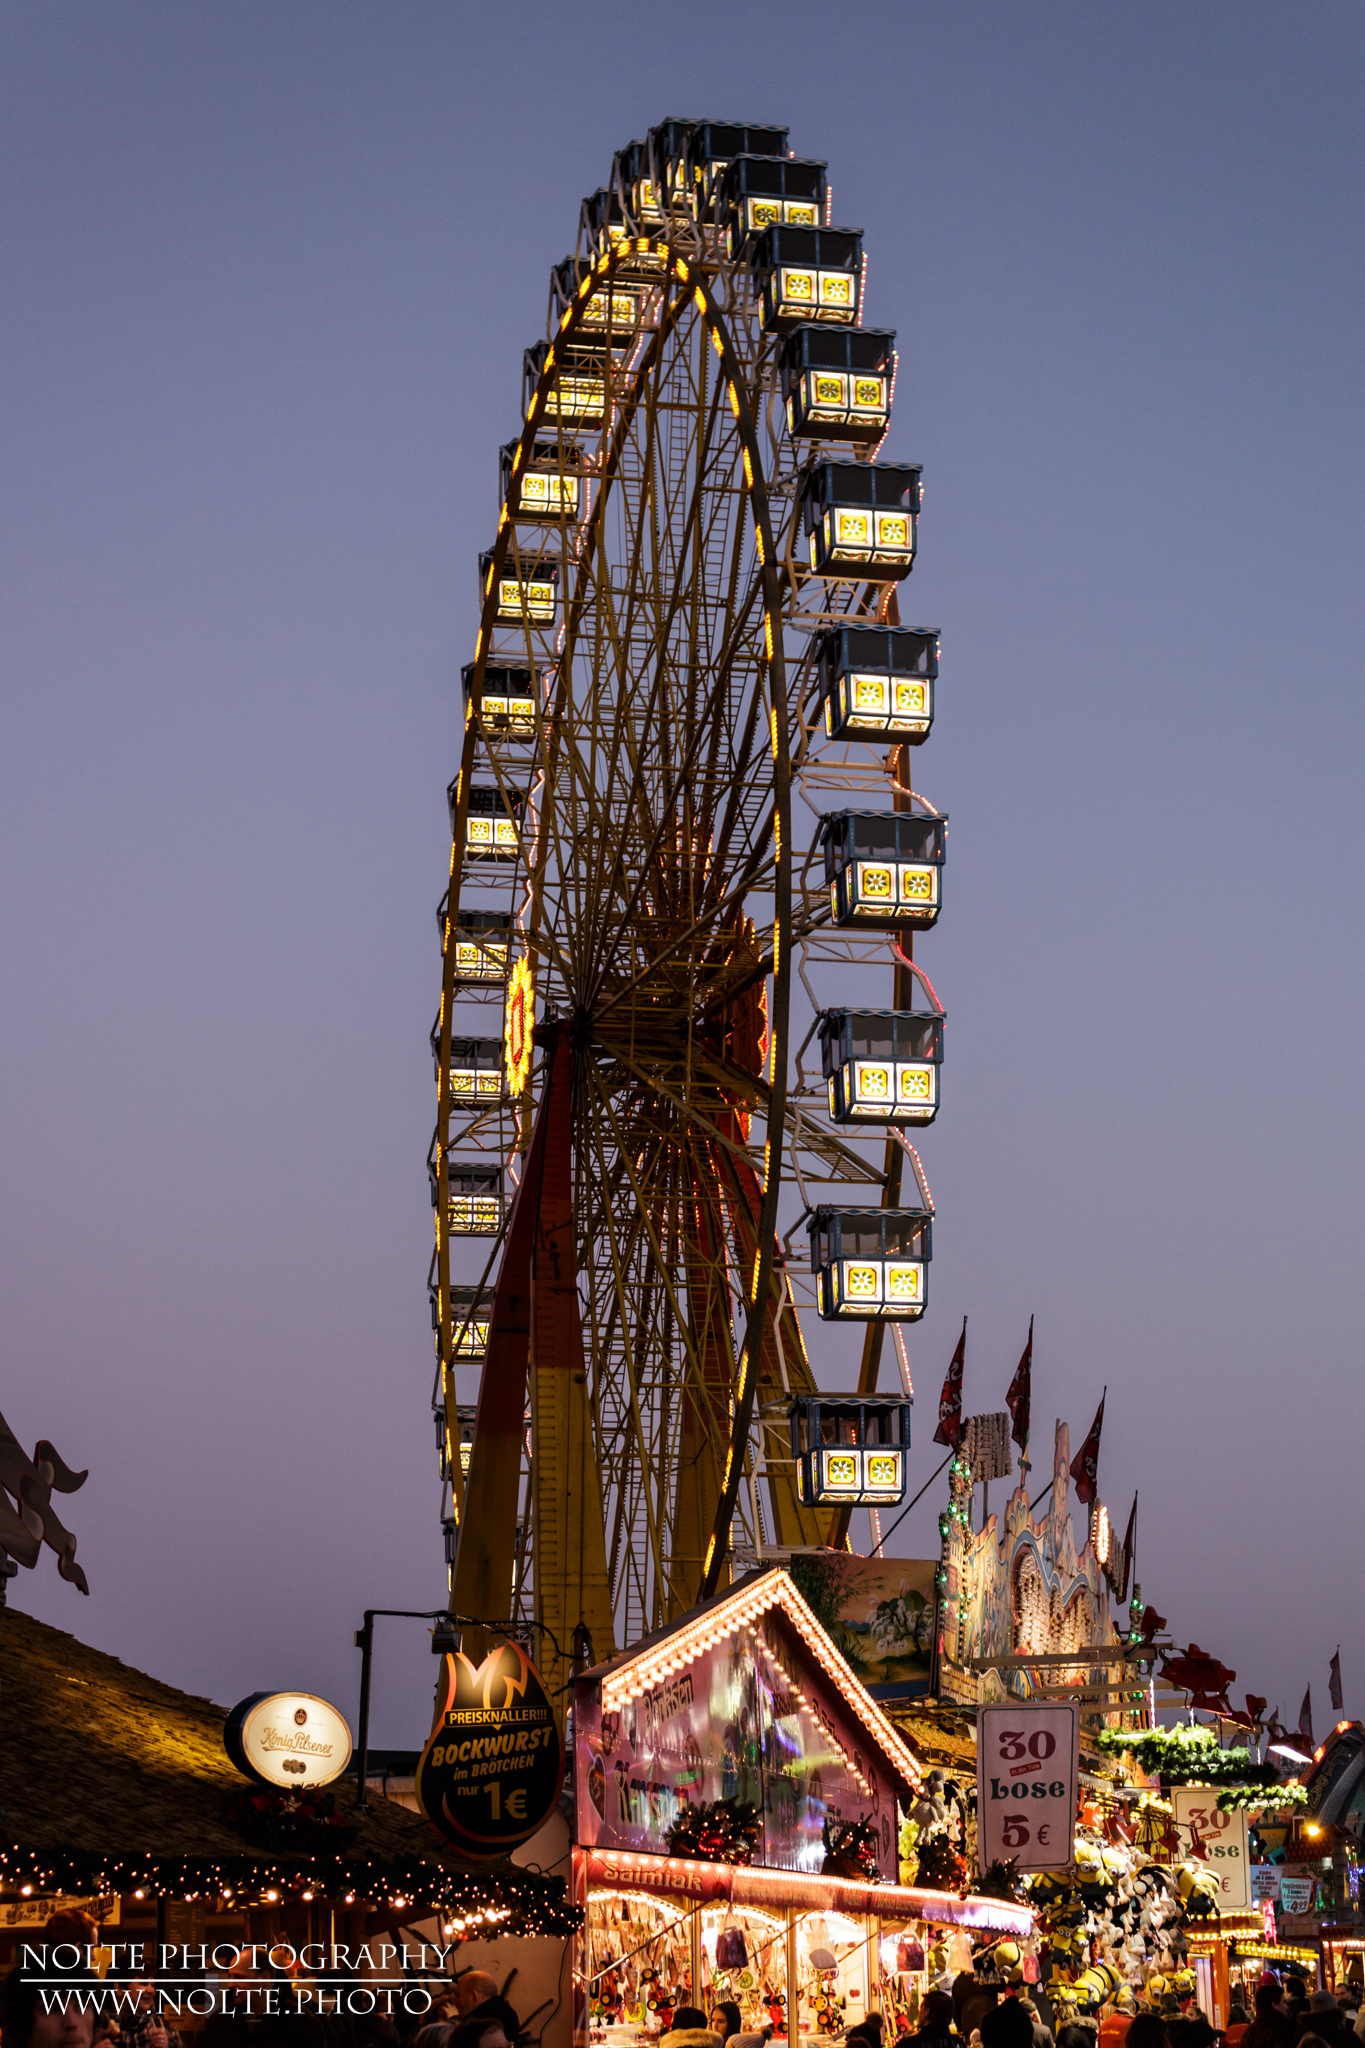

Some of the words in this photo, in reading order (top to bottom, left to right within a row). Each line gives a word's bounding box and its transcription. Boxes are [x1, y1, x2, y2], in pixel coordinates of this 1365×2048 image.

[449, 1708, 547, 1725] PREISKNALLER!!!
[260, 1727, 293, 1752] König
[293, 1731, 333, 1754] Pilsener
[431, 1726, 553, 1767] BOCKWURST
[998, 1730, 1056, 1760] 30
[453, 1767, 468, 1780] im
[471, 1754, 535, 1777] BRÖTCHEN
[457, 1786, 479, 1796] nur
[990, 1777, 1065, 1800] Lose
[1002, 1814, 1030, 1848] 5
[1037, 1824, 1050, 1846] €
[1188, 1808, 1231, 1830] 30
[603, 1861, 703, 1891] Salmiak
[1220, 1876, 1231, 1893] €
